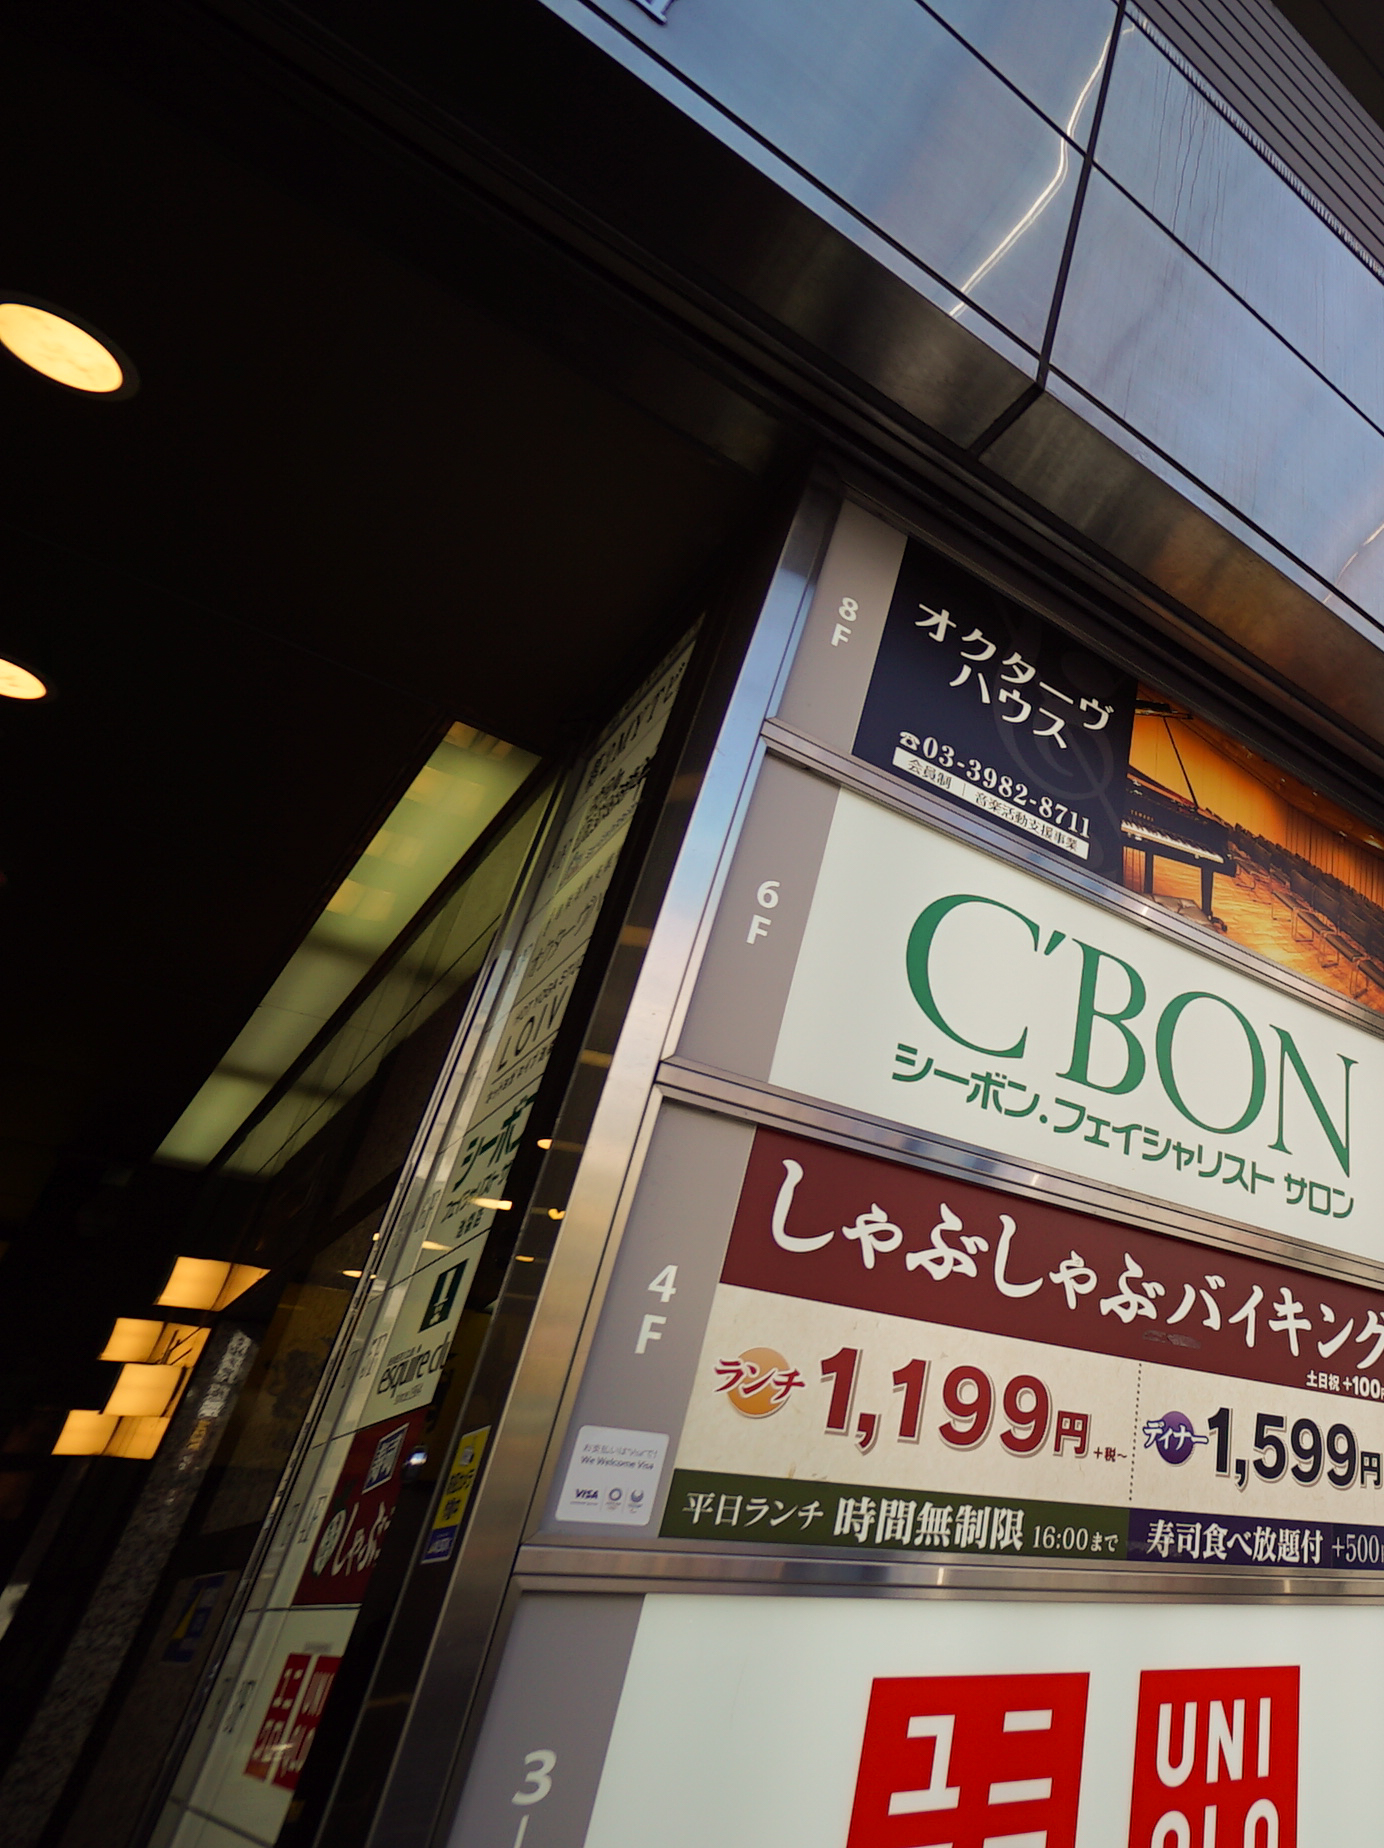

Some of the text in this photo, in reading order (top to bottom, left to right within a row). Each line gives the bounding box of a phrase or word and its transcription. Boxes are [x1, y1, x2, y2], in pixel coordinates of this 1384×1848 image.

[914, 602, 1115, 732] オクターヴ
[949, 664, 1070, 751] ハウス
[907, 757, 953, 791] 会員制
[922, 734, 1091, 840] 03-3982-8711
[1284, 1173, 1354, 1219] サロン
[714, 1357, 806, 1398] ランチ
[1306, 1370, 1340, 1391] 土日祝
[1143, 1419, 1208, 1449] ディナー
[637, 1461, 654, 1470] Visa
[575, 1489, 598, 1499] VISA
[682, 1492, 1119, 1553] 平日ランチ 時間無制限 16:00まで
[1147, 1519, 1323, 1564] 寿司食べ放題付
[887, 1708, 1054, 1816] ユニ
[1155, 1697, 1272, 1789] UNI
